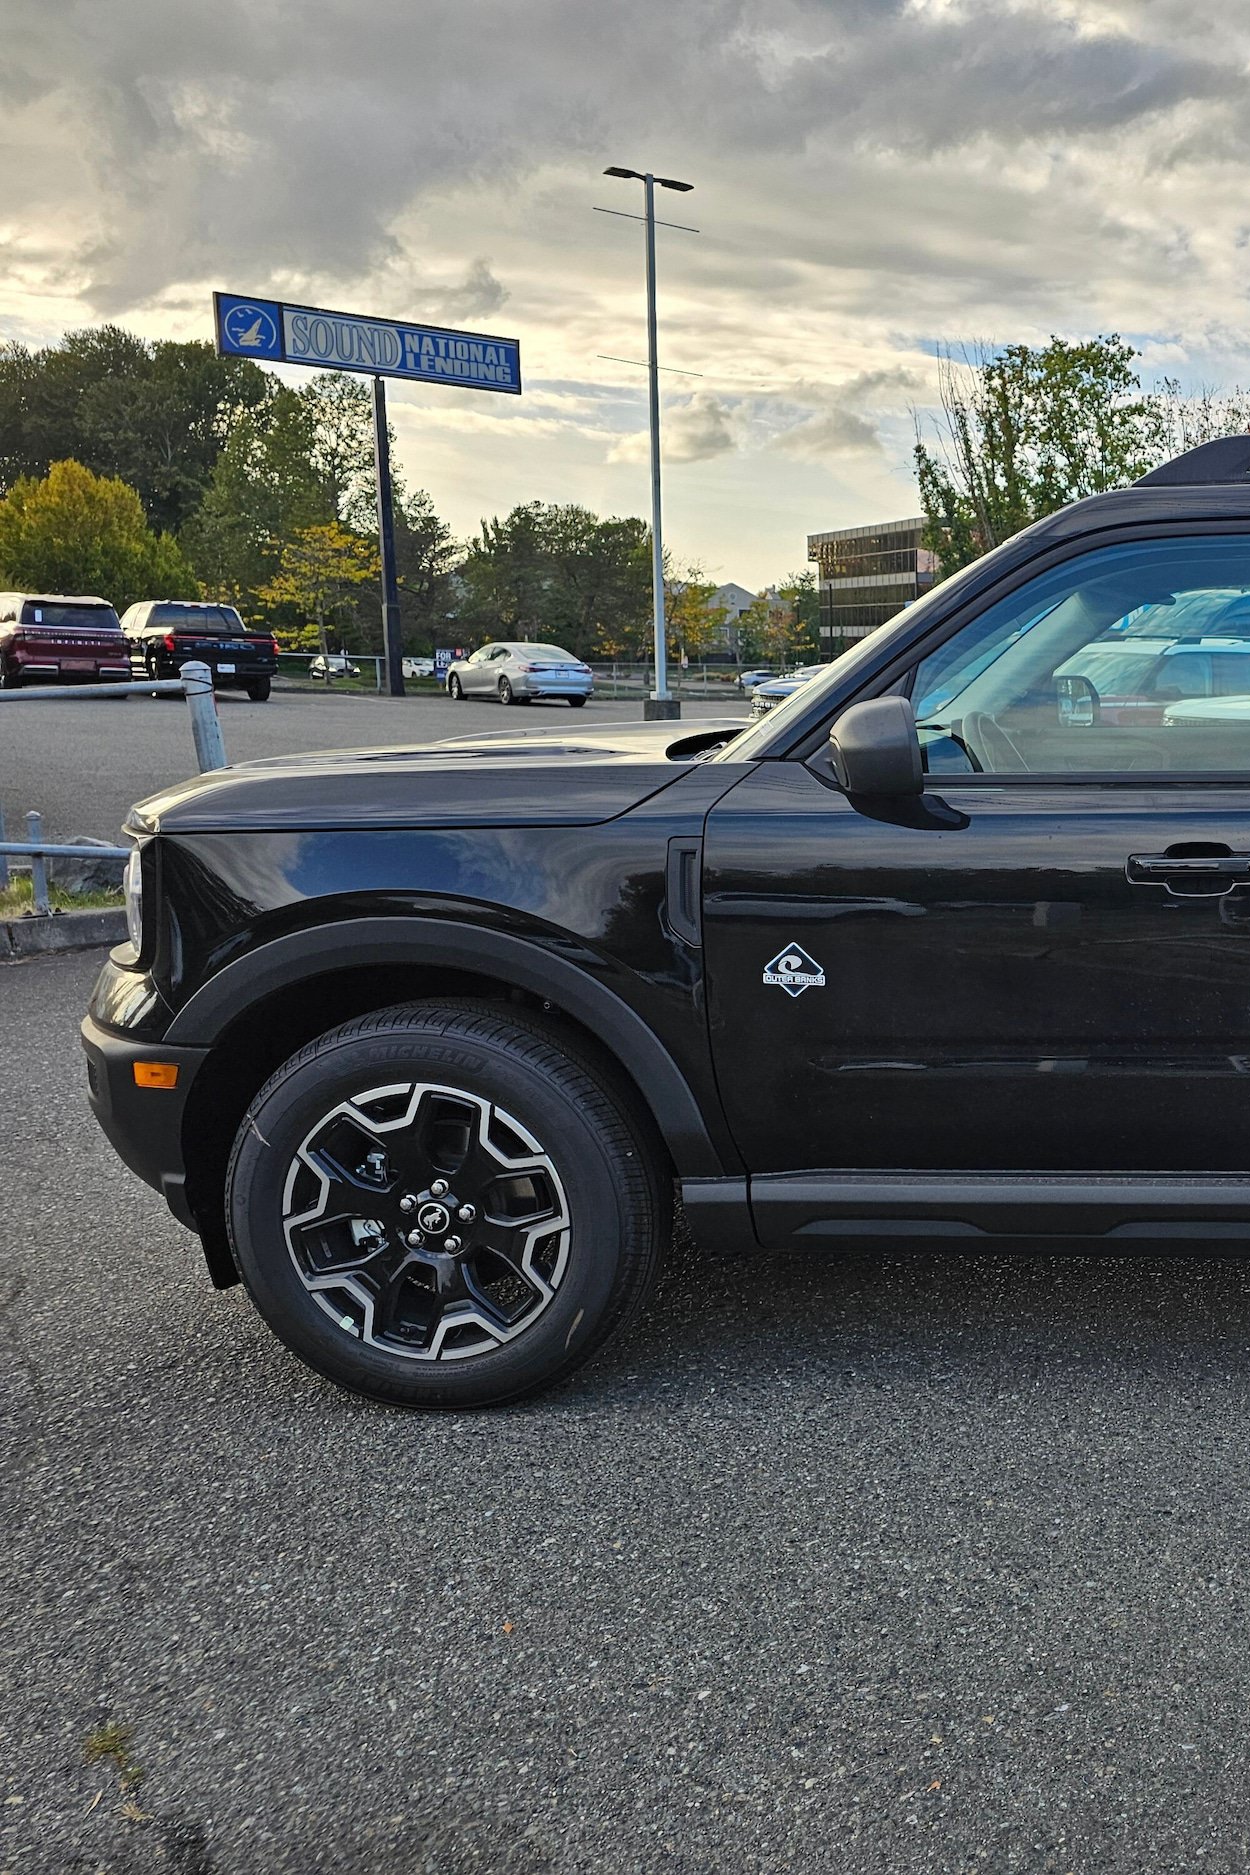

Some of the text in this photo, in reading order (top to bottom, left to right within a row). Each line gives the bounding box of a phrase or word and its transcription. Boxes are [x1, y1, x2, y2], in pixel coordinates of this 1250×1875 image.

[291, 315, 399, 367] SOUND
[404, 333, 509, 365] NATIONAL
[406, 354, 512, 384] LENDING
[766, 975, 823, 984] OUTER BANKS
[367, 1045, 483, 1072] MICHELIN
